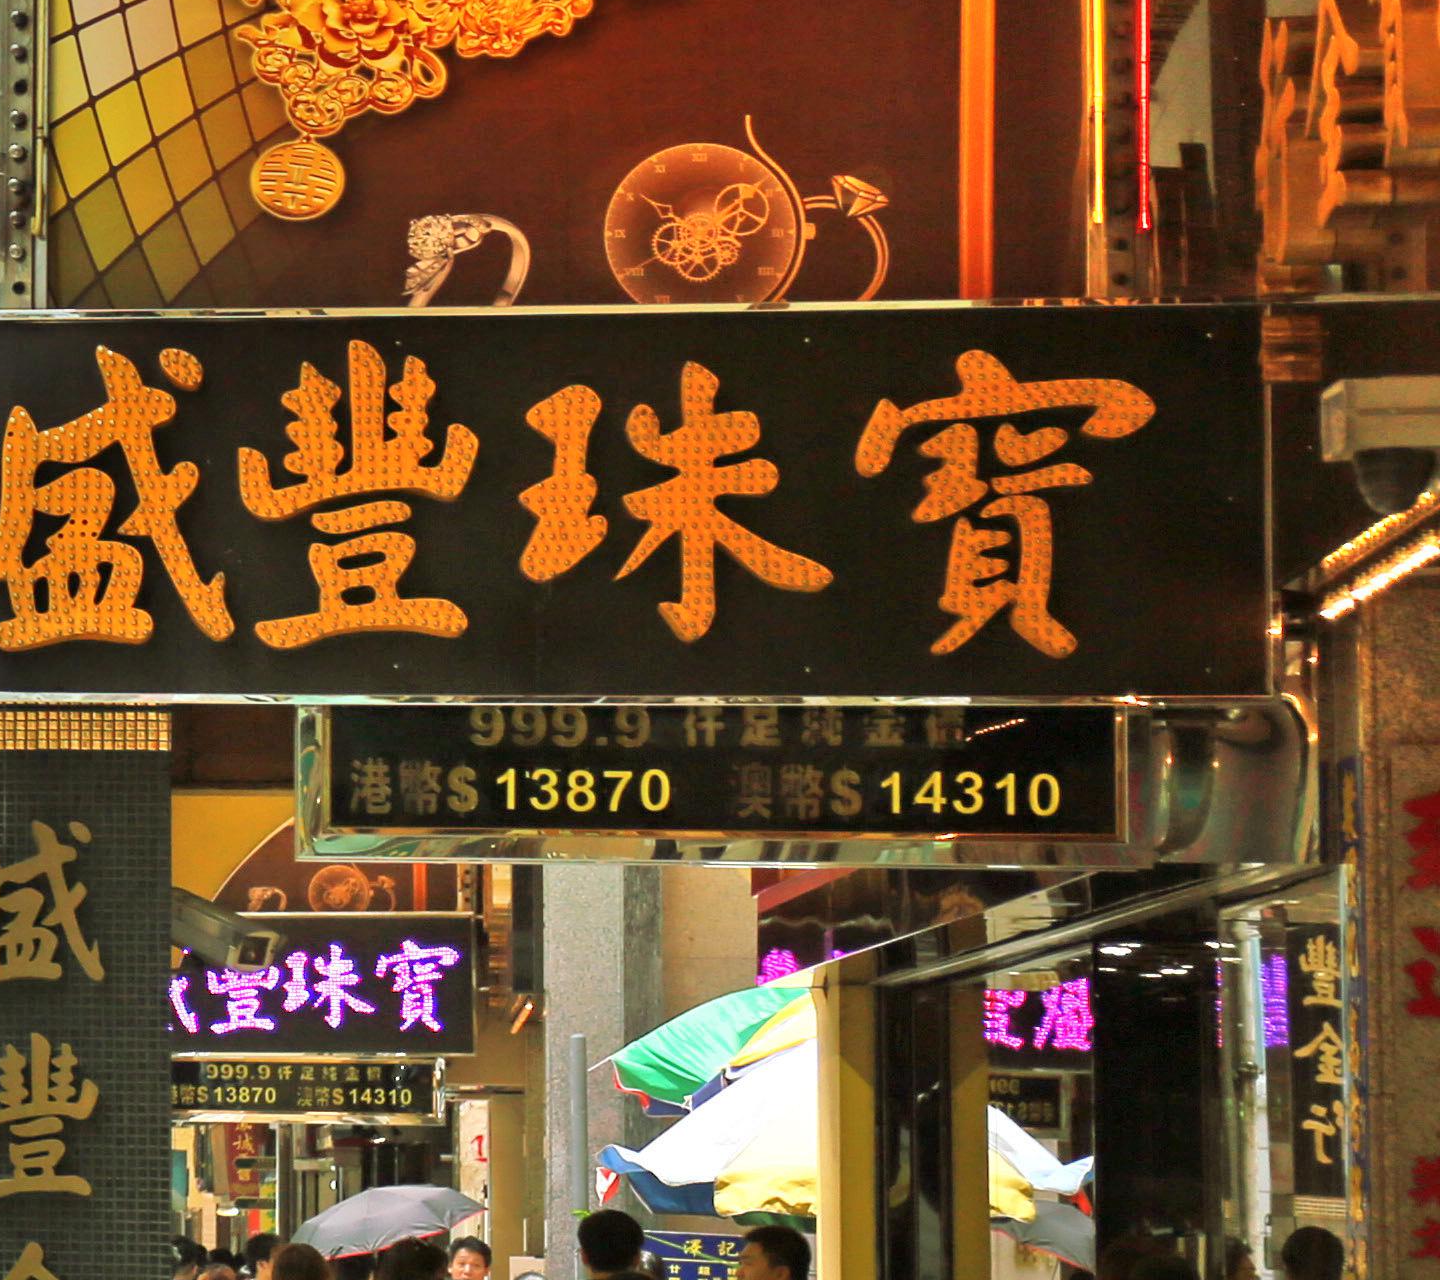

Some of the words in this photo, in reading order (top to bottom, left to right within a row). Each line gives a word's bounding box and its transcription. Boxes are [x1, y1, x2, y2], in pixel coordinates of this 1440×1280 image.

[881, 770, 1061, 817] 14310
[169, 939, 461, 1034] 豐珠寶
[207, 1063, 271, 1081] 999.9
[213, 1086, 277, 1105] 13870
[348, 1088, 413, 1106] 14310
